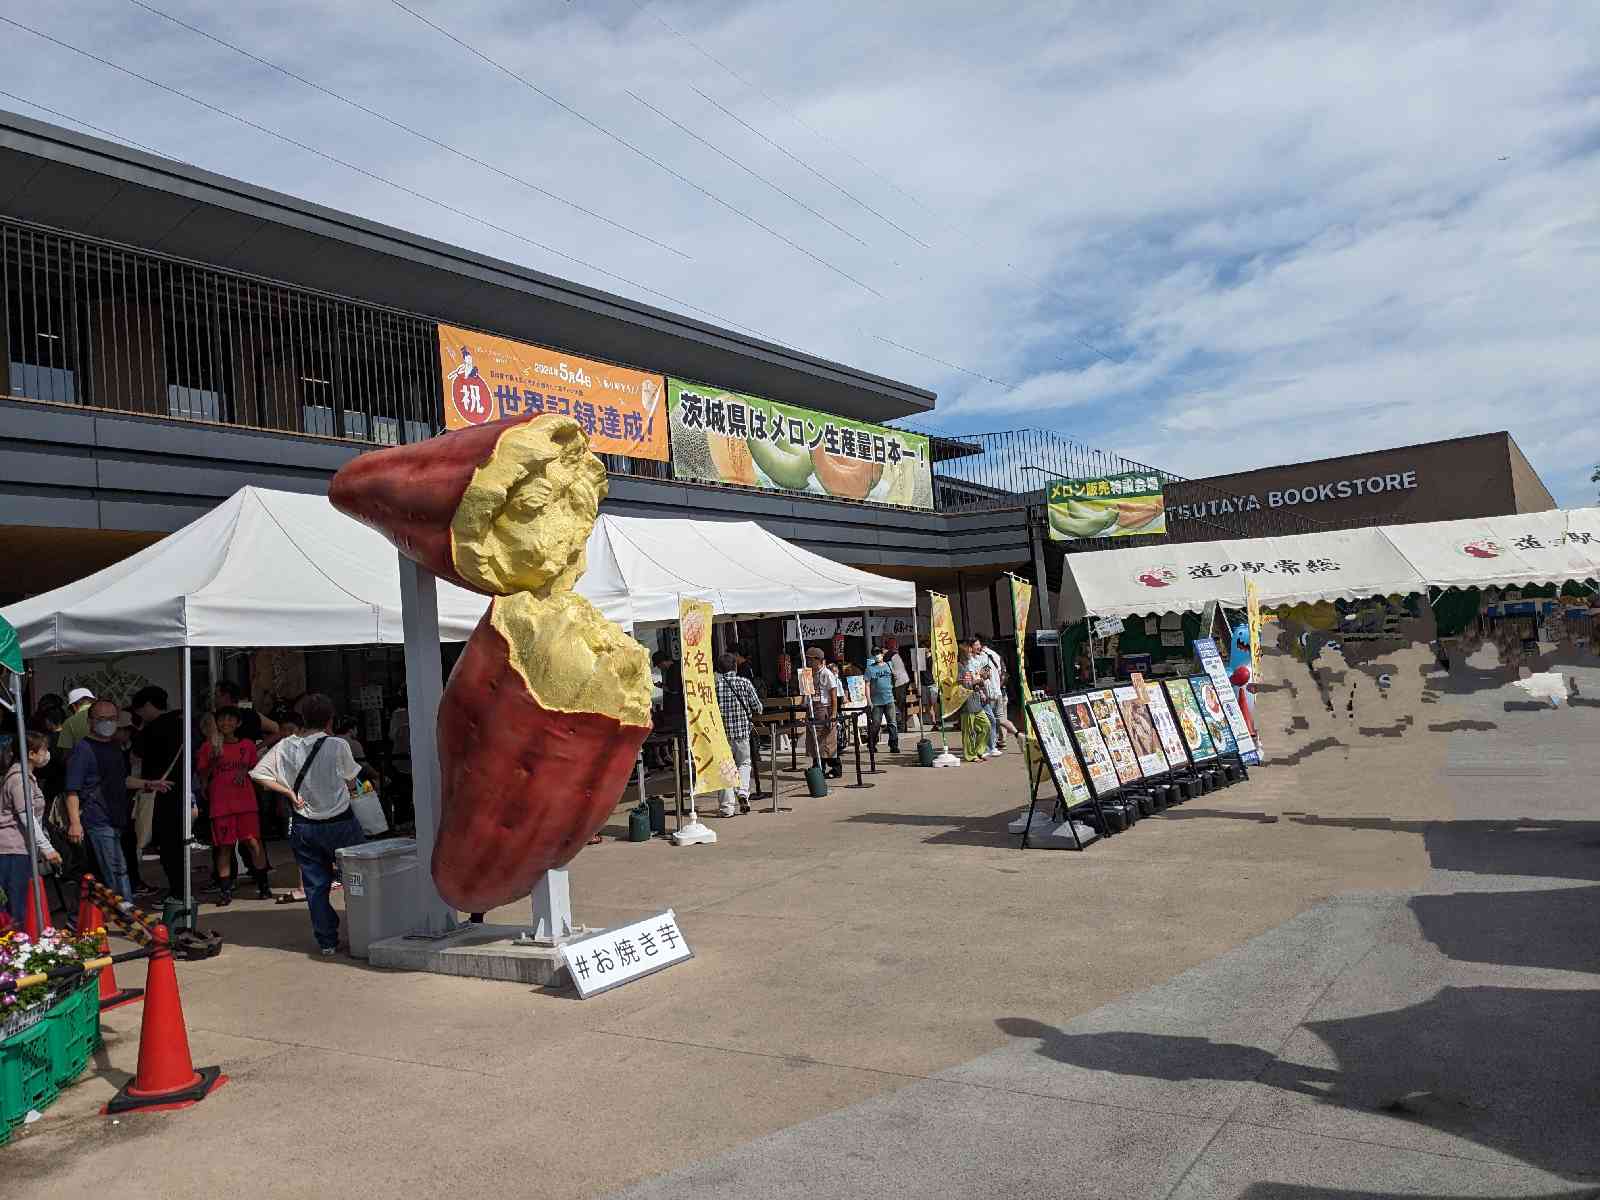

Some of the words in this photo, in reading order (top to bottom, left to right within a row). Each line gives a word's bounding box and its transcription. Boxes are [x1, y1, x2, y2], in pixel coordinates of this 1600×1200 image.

[461, 384, 485, 414] 祝
[494, 384, 654, 443] 世界記録達成!
[680, 390, 926, 468] 茨城県はメロン生産量日本一!
[1166, 494, 1261, 521] TSUTAYA
[1268, 470, 1418, 508] BOOKSTORE
[1187, 557, 1343, 580] 道の駅常総
[575, 922, 681, 981] #お焼き芋
